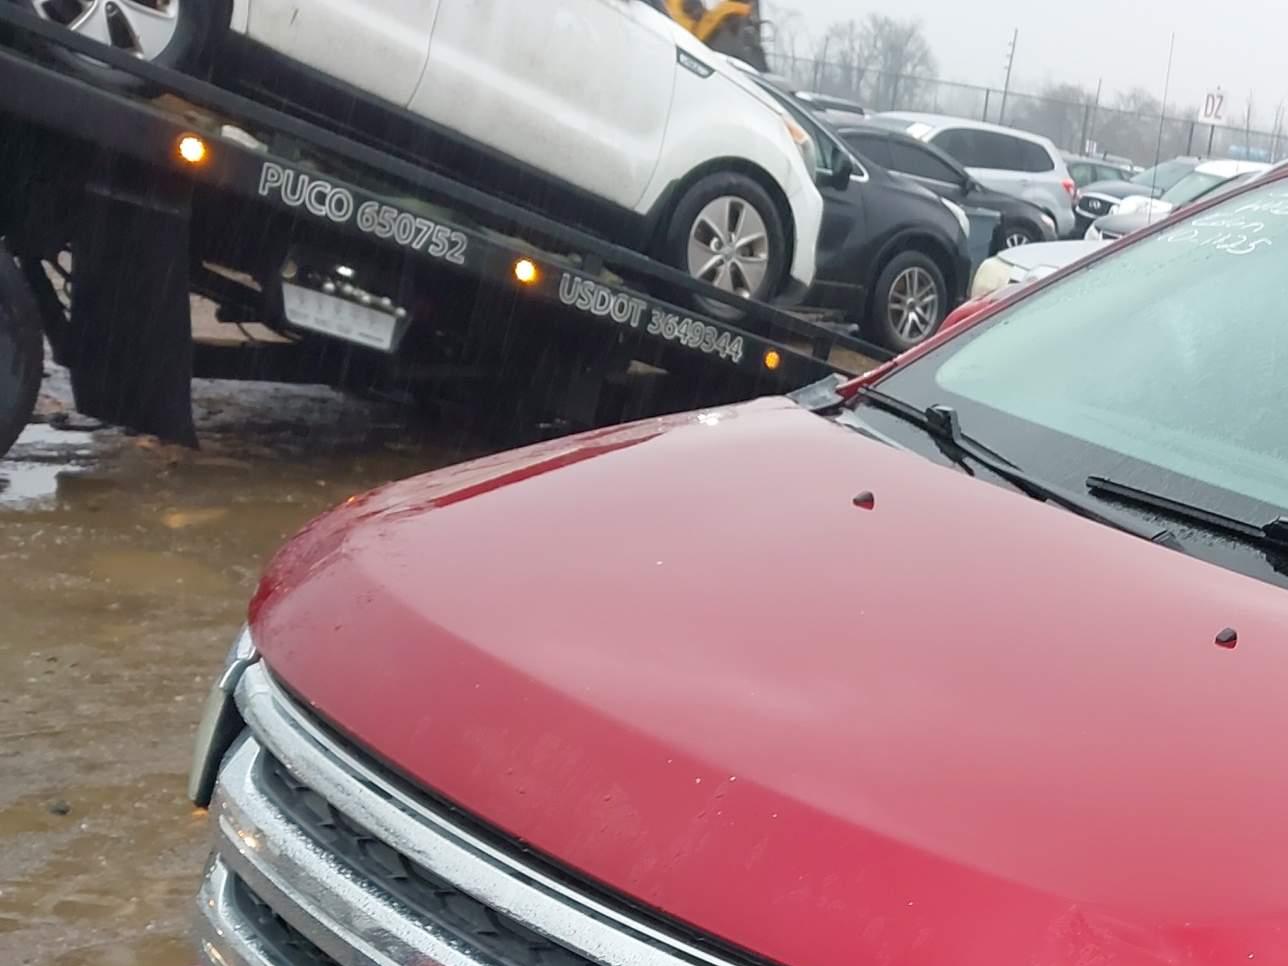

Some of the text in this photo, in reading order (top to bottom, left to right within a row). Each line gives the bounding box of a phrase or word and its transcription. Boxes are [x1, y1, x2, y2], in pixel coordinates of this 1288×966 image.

[258, 162, 469, 265] PUCO 650752
[559, 272, 744, 364] USDOT 3649344
